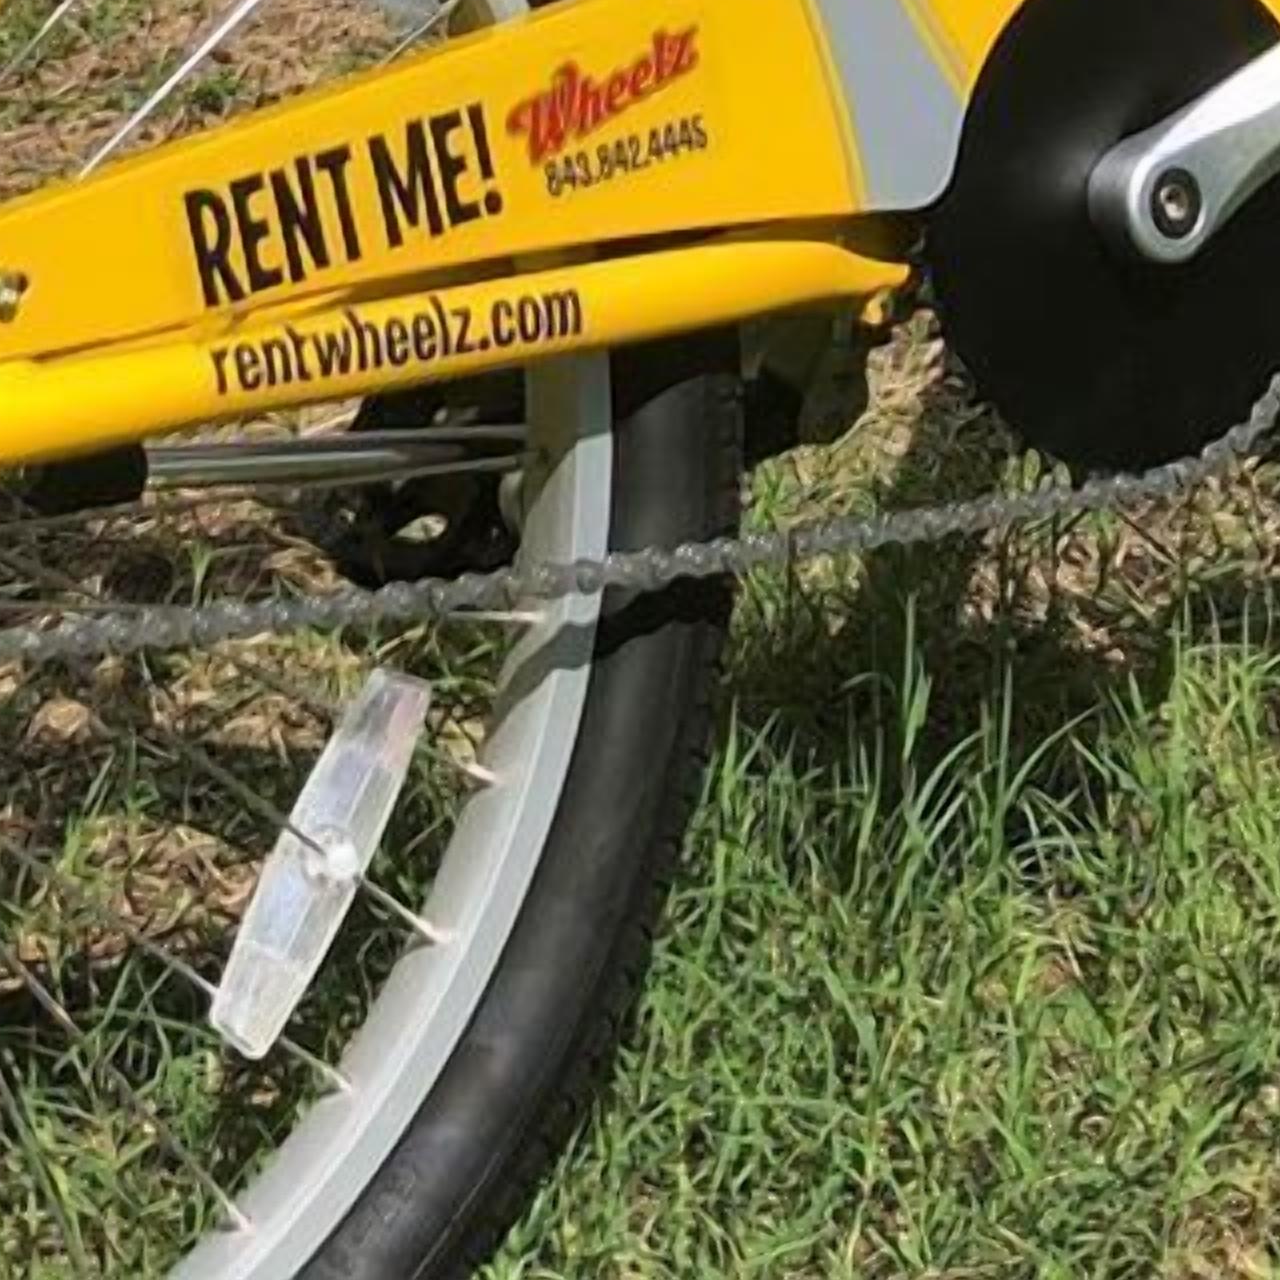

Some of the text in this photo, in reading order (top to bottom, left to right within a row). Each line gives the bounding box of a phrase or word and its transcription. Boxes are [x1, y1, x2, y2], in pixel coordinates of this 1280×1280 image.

[506, 23, 700, 166] Wheelz
[184, 102, 503, 307] RENT ME!
[210, 288, 582, 395] rentwheelz.com
